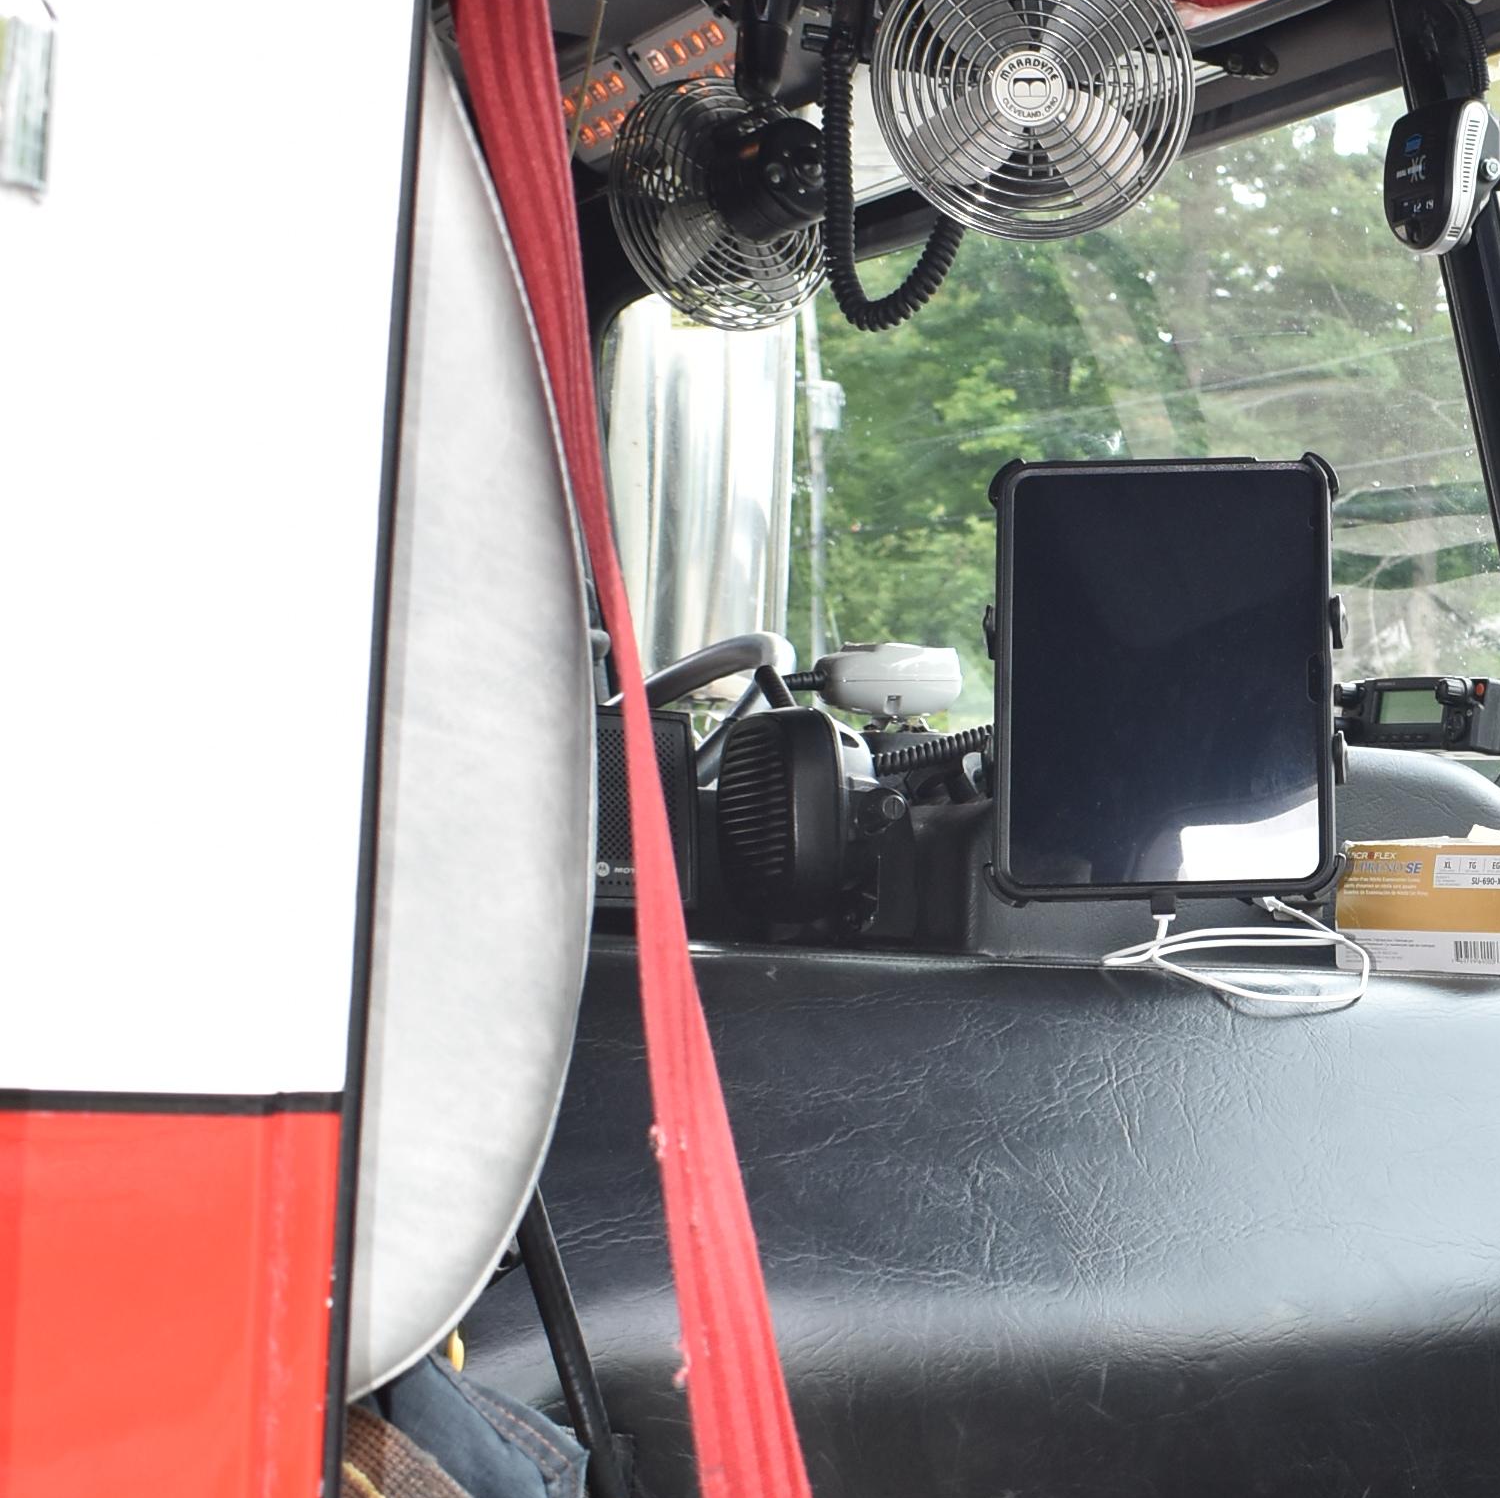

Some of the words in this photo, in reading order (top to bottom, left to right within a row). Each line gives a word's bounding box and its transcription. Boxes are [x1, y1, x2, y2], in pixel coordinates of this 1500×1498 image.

[1000, 57, 1059, 81] MARADYNE
[1044, 96, 1058, 113] OHIO
[1406, 862, 1423, 874] SE
[1443, 861, 1451, 869] XL
[1468, 861, 1477, 870] TG
[1492, 861, 1500, 870] EG
